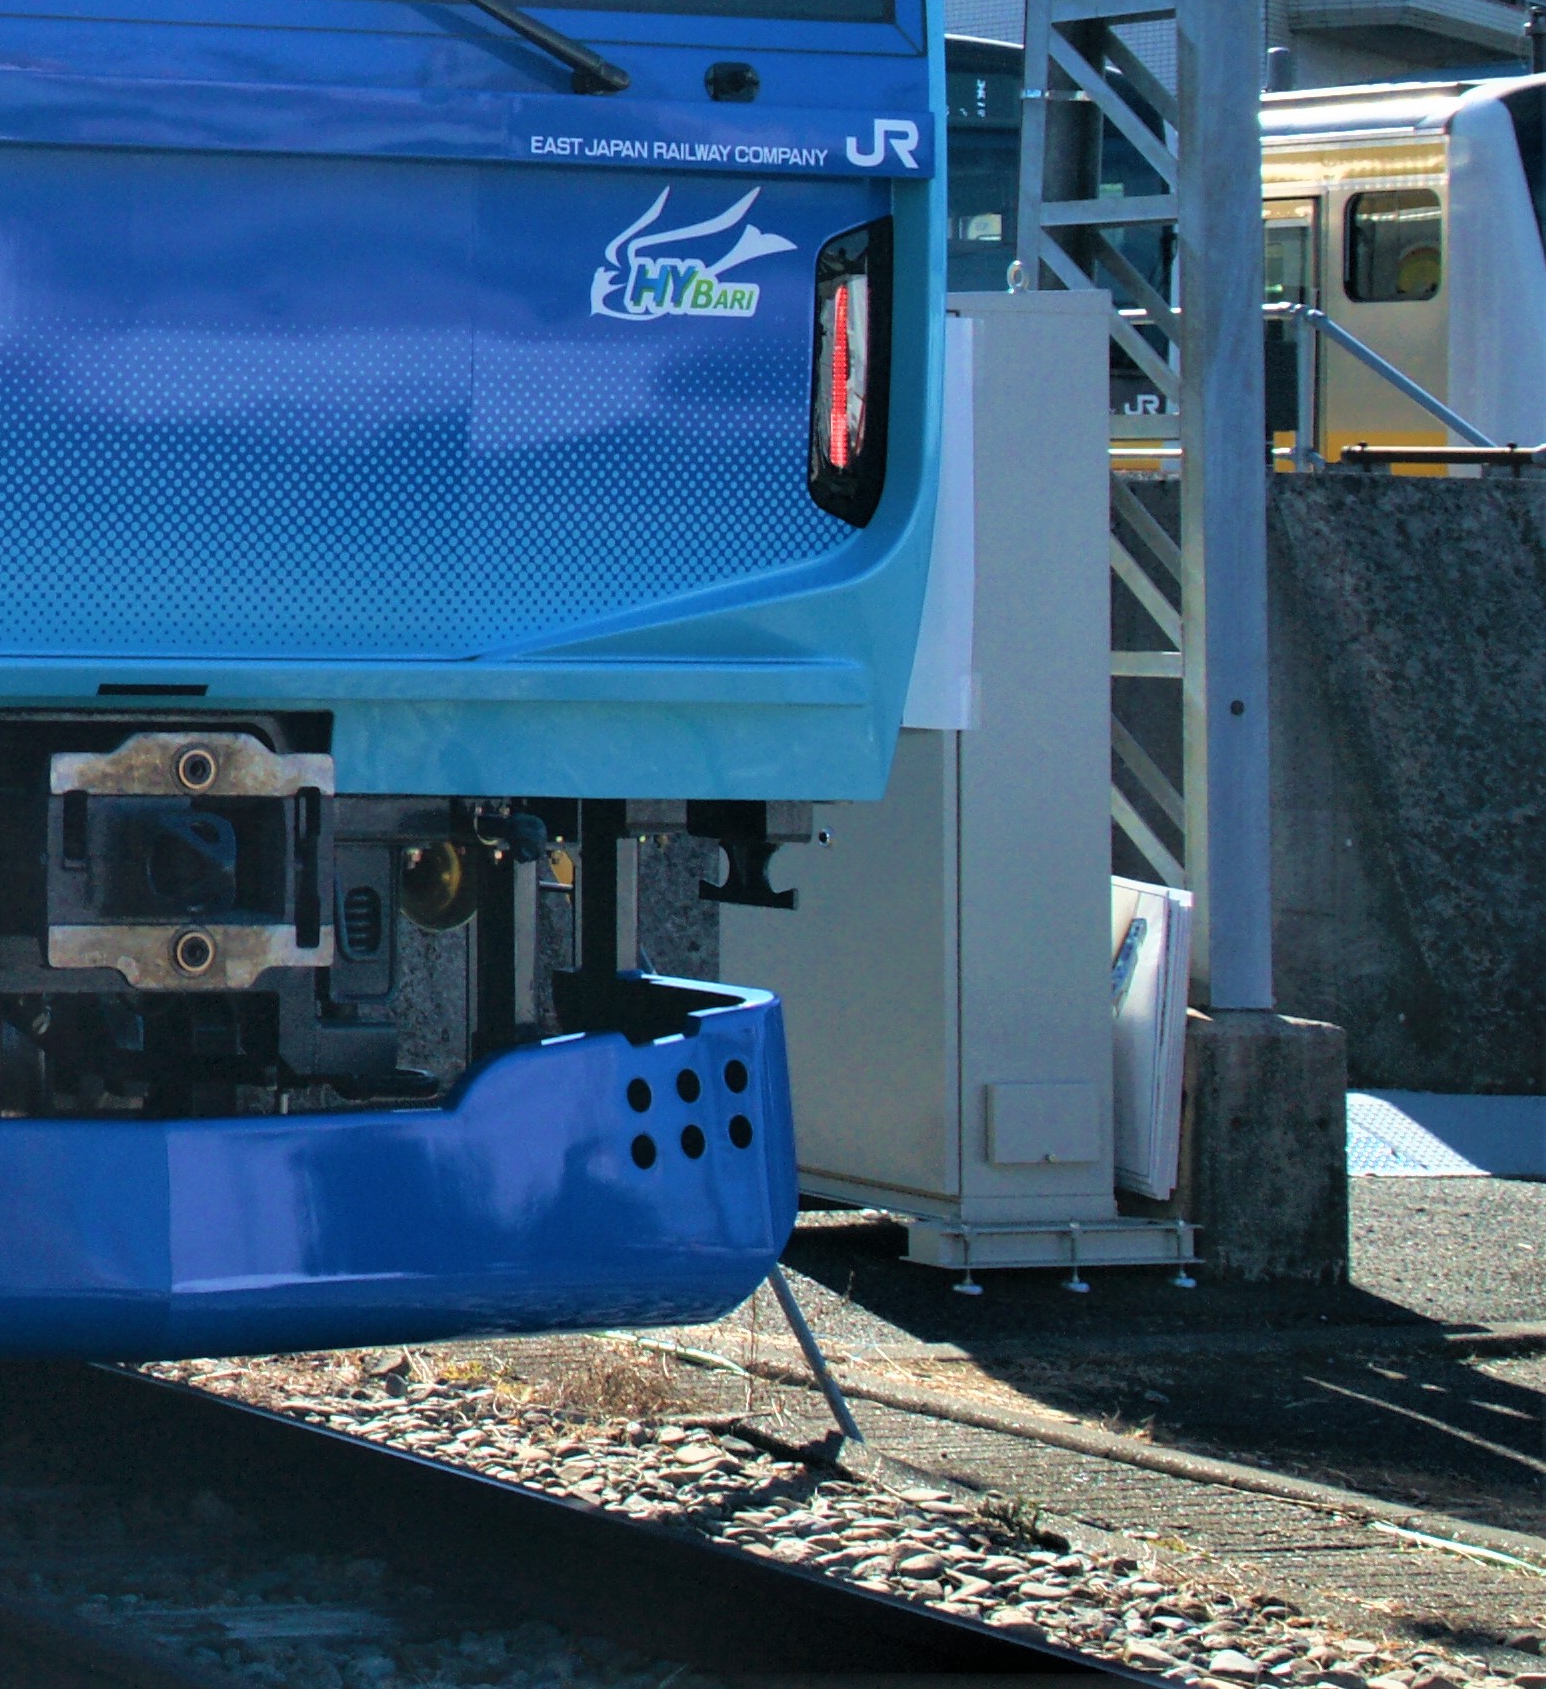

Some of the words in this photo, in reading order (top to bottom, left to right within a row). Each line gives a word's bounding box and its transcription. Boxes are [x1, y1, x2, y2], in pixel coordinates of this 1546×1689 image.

[530, 135, 584, 157] EAST
[585, 139, 648, 160] JAPAN
[653, 141, 732, 163] RAILWAY
[734, 145, 829, 167] COMPANY
[845, 118, 920, 170] JR
[627, 260, 759, 313] HYBARI
[1123, 393, 1160, 415] JR
